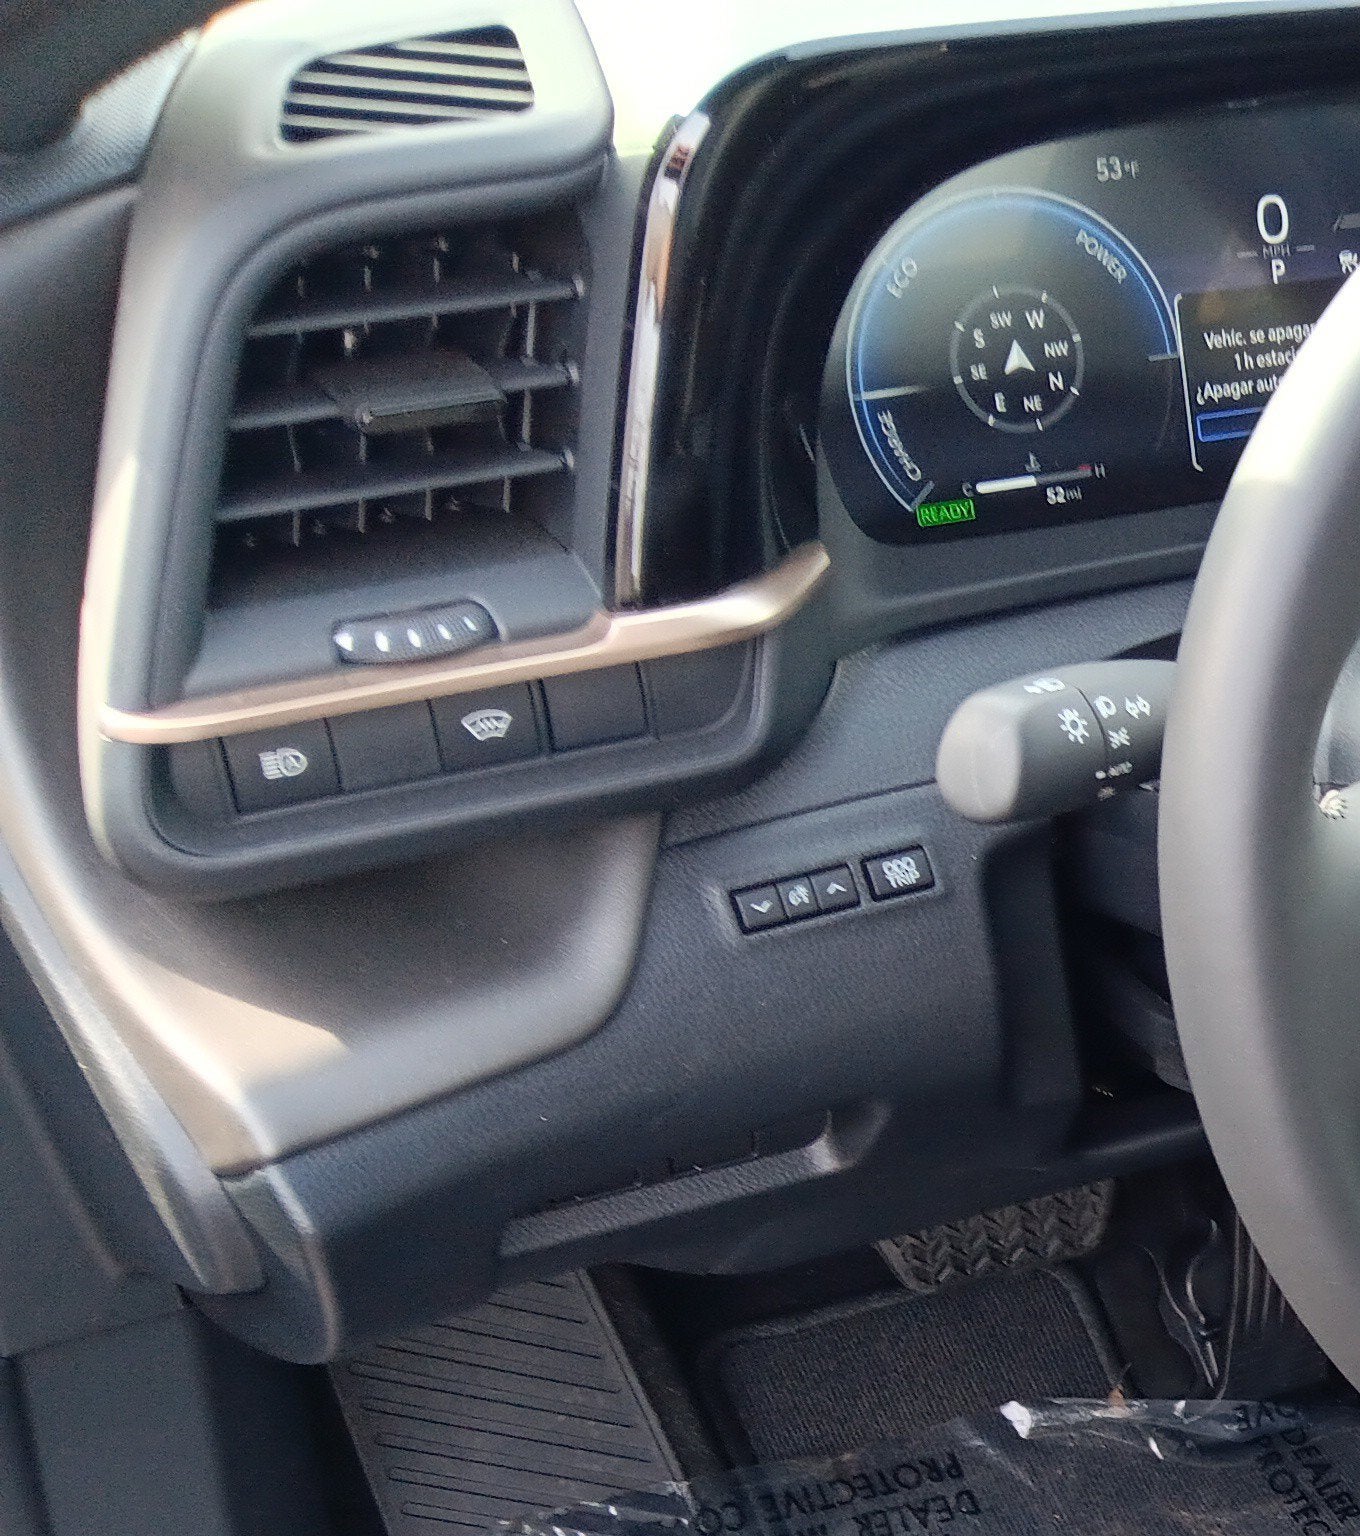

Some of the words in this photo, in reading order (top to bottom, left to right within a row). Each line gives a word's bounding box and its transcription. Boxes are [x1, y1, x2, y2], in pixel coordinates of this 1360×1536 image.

[1256, 194, 1290, 245] 0
[1075, 228, 1128, 285] POWER
[886, 256, 919, 299] ECO
[1271, 259, 1286, 285] P
[989, 309, 1012, 330] SW
[1024, 308, 1046, 329] W
[973, 327, 985, 349] S
[1043, 339, 1069, 358] NW
[969, 362, 988, 381] SE
[1047, 370, 1065, 392] N
[993, 391, 1007, 413] E
[1023, 394, 1043, 413] NE
[918, 500, 973, 525] READY
